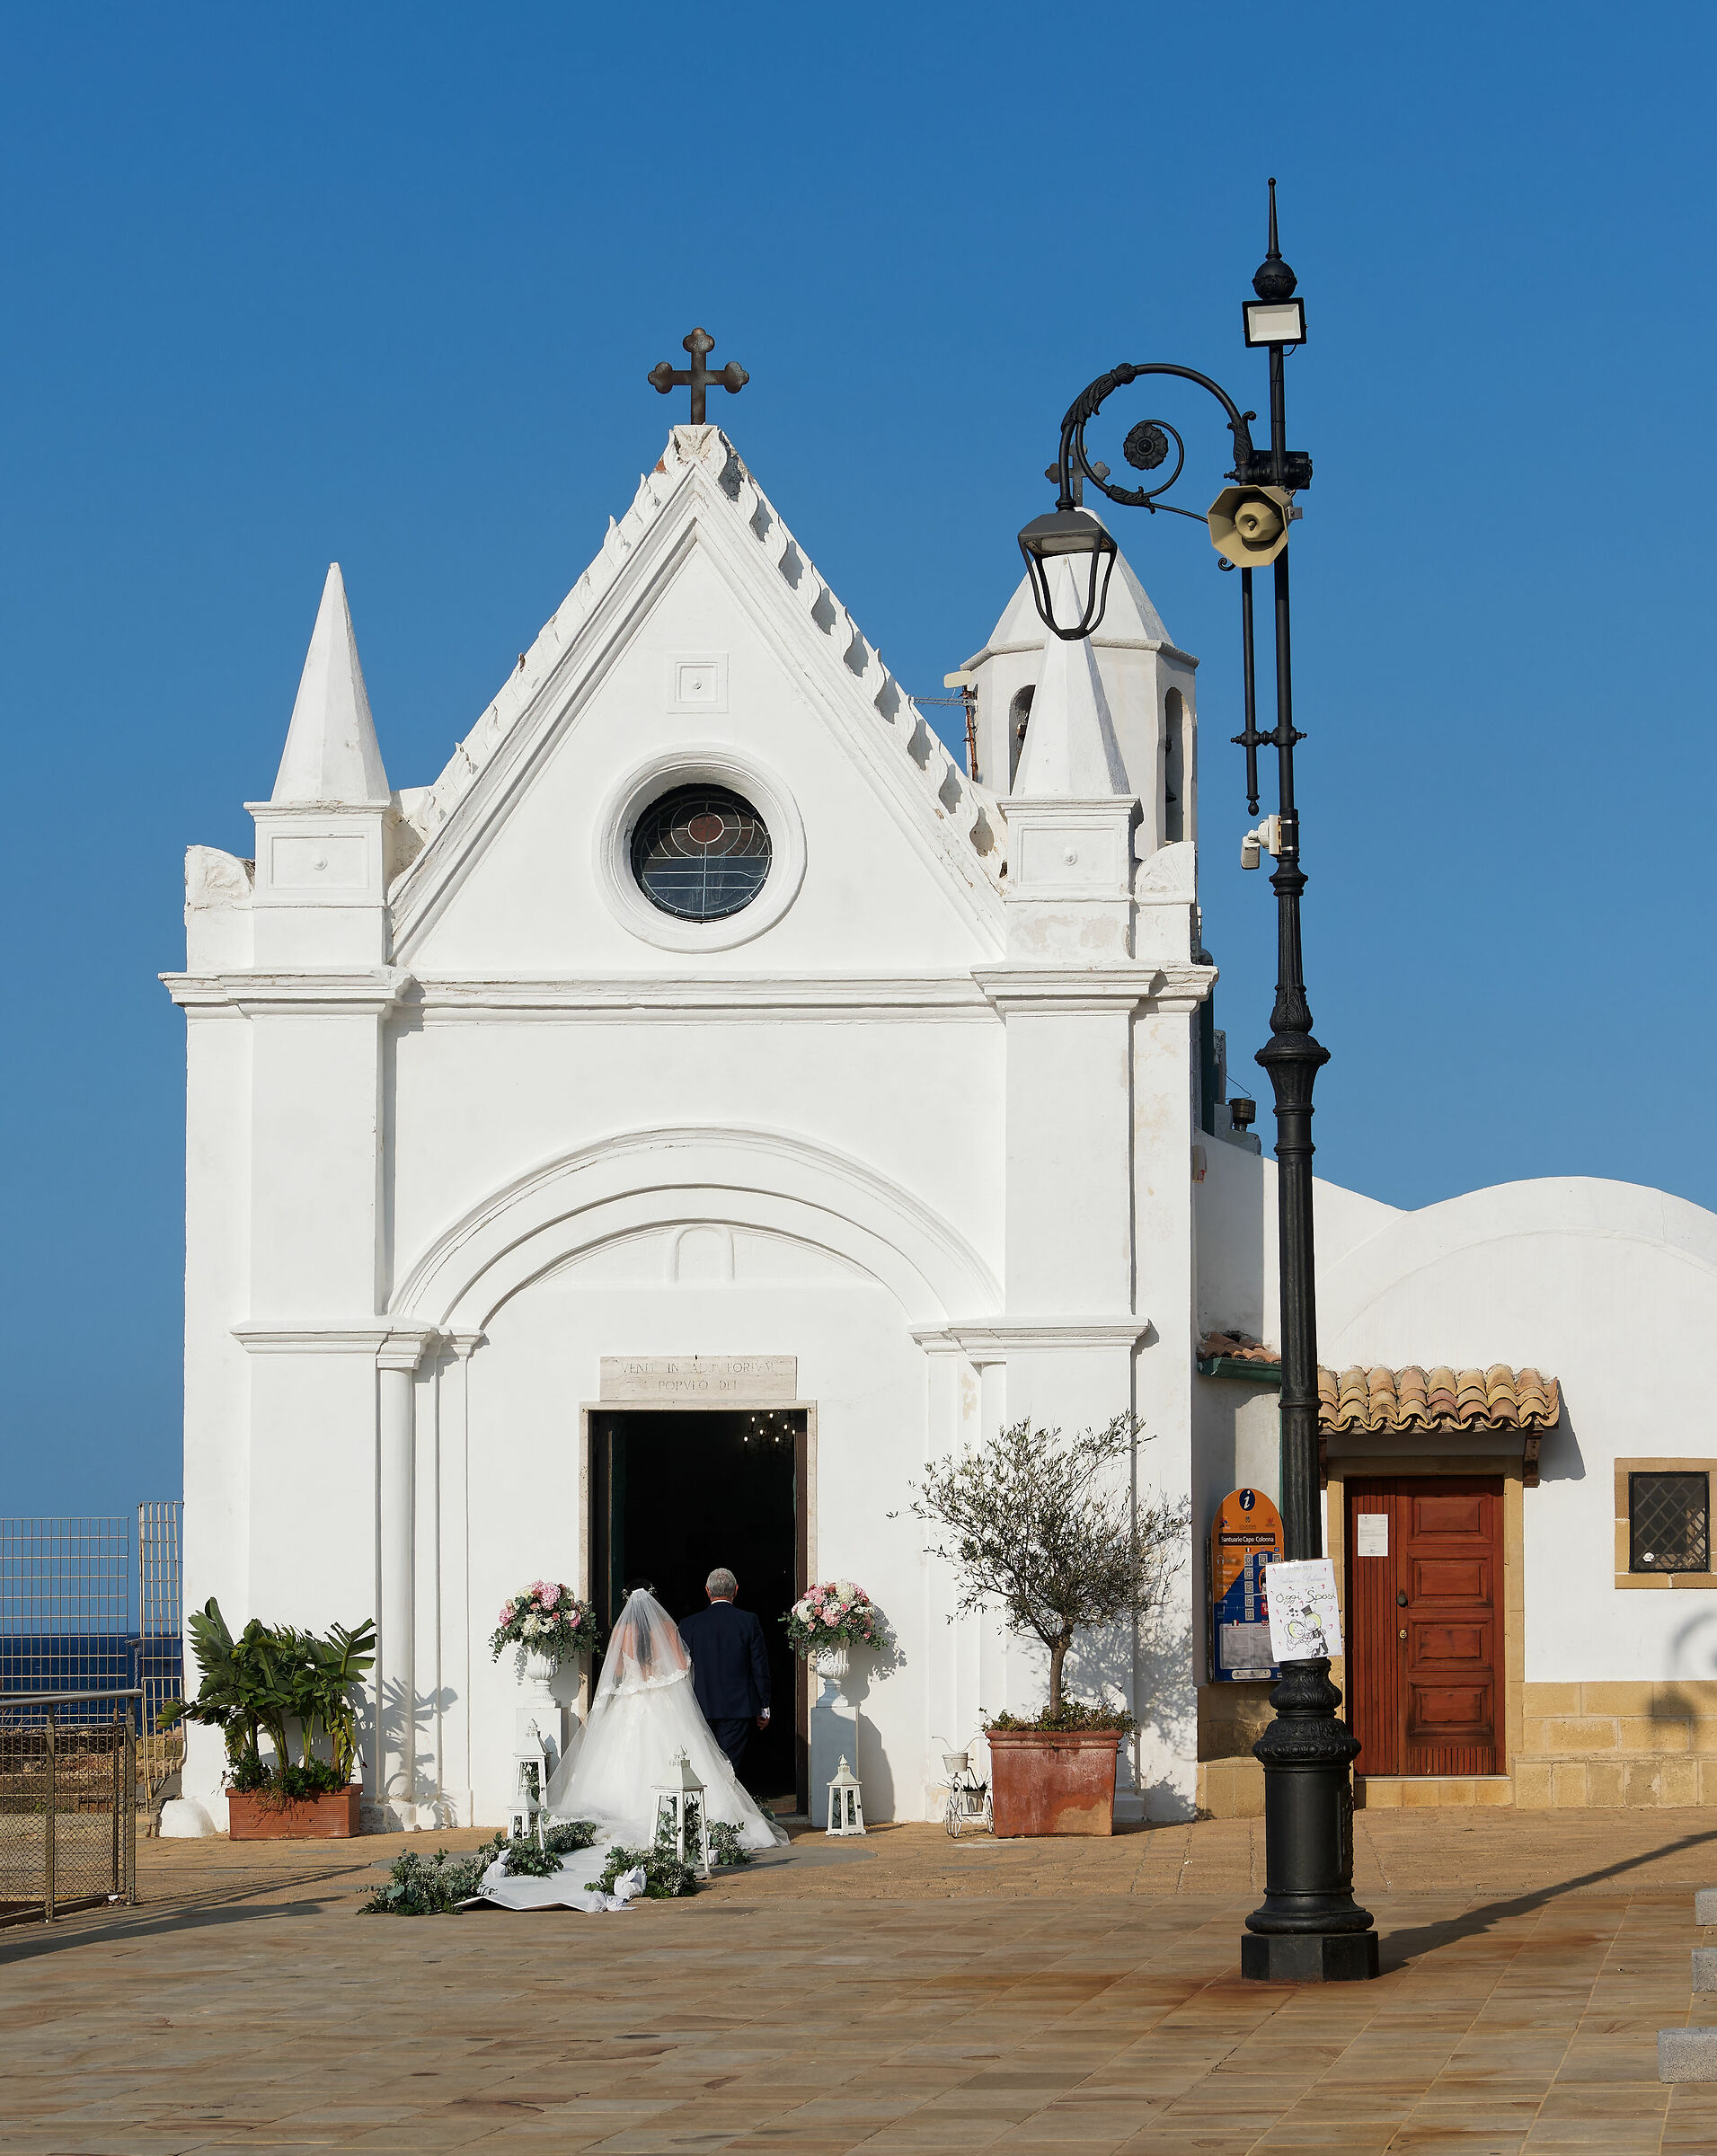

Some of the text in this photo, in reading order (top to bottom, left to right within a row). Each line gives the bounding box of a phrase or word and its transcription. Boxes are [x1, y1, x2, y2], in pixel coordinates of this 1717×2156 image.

[668, 1363, 680, 1374] IN
[1275, 1588, 1336, 1605] Oggi Sposi
